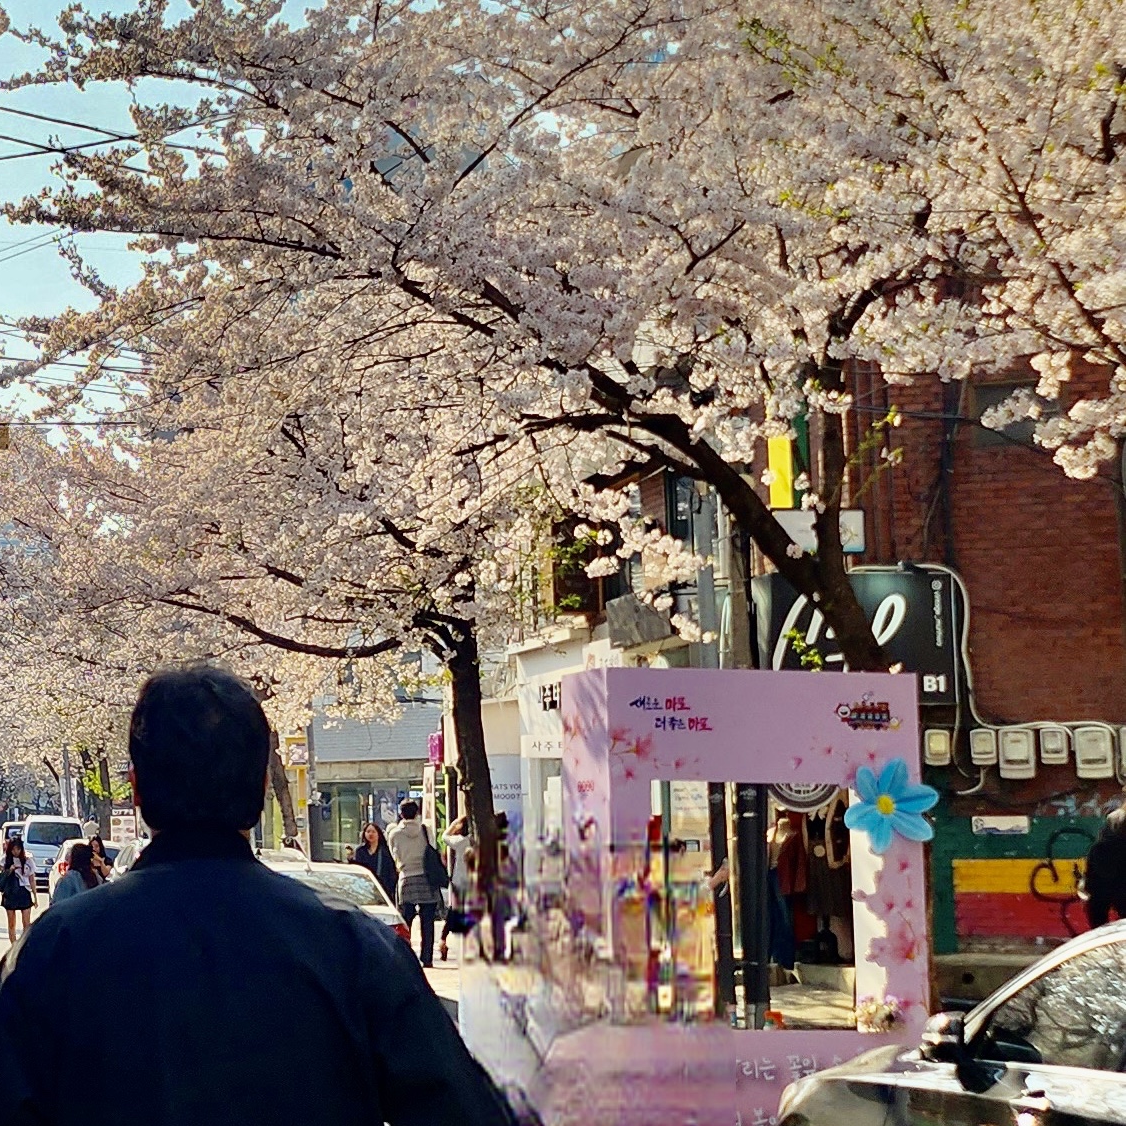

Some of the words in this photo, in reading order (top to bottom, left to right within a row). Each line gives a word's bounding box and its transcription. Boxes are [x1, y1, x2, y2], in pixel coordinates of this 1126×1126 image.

[923, 675, 946, 693] B1
[665, 696, 690, 712] 마포
[655, 716, 666, 731] 더
[688, 716, 712, 731] 마포
[736, 1057, 776, 1080] 리는
